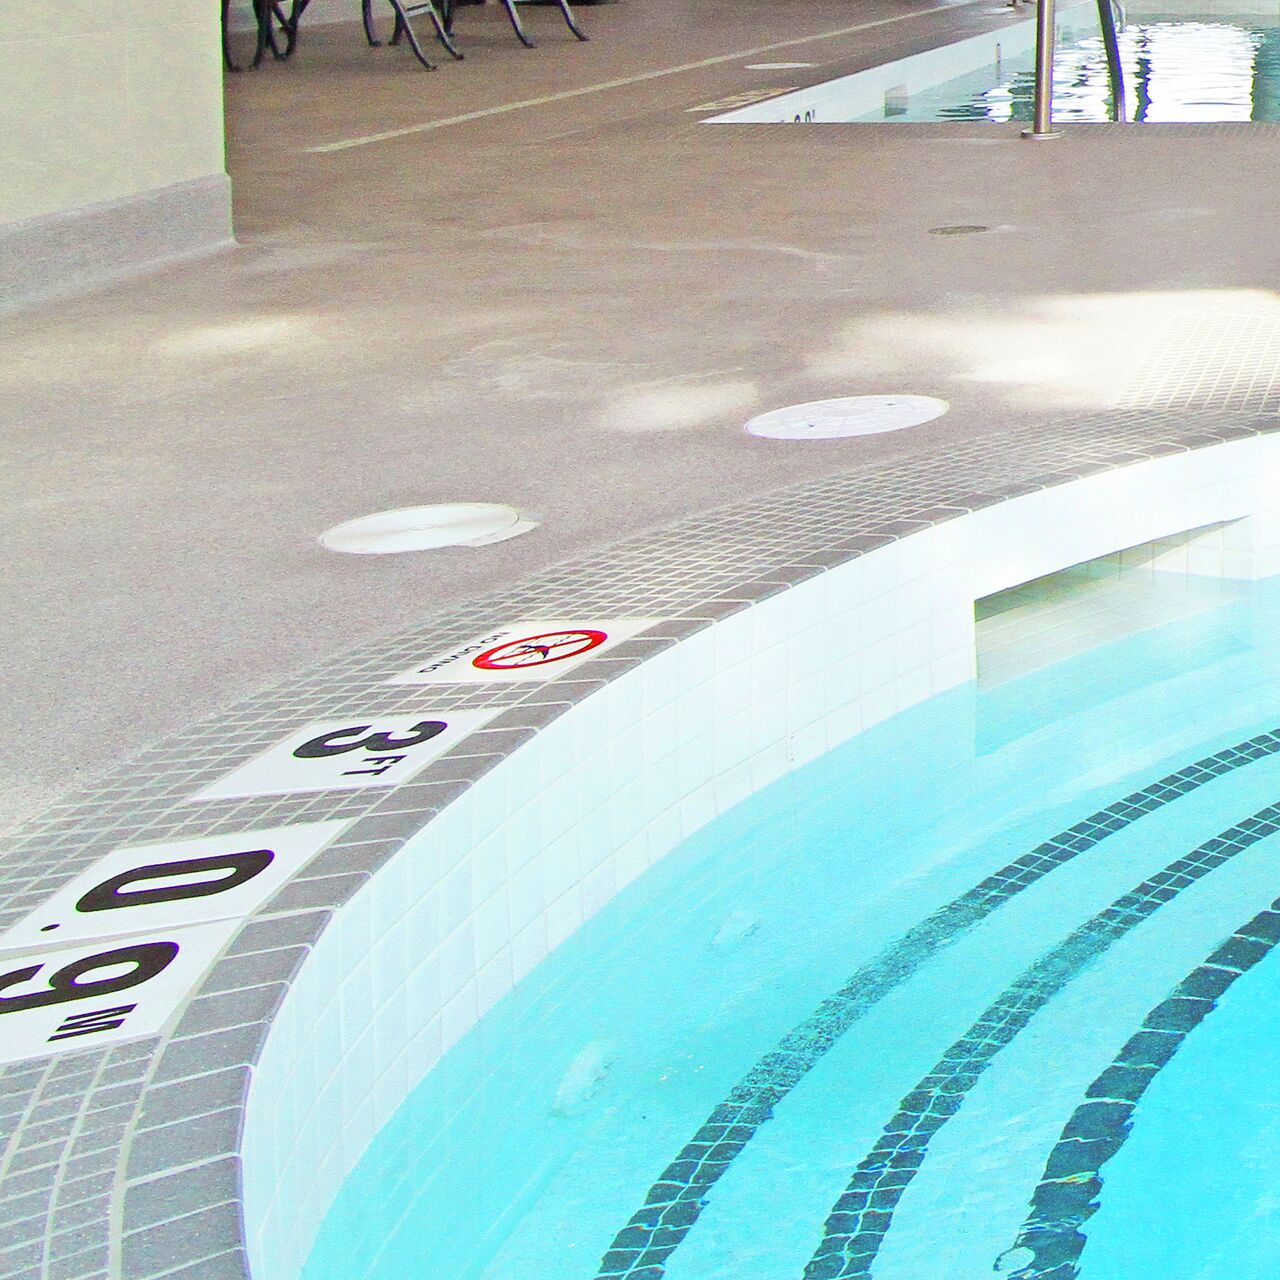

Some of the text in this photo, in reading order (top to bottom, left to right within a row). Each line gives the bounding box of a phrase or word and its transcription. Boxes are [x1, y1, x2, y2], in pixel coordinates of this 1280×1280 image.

[292, 721, 448, 776] 3 FT
[46, 1003, 139, 1043] M
